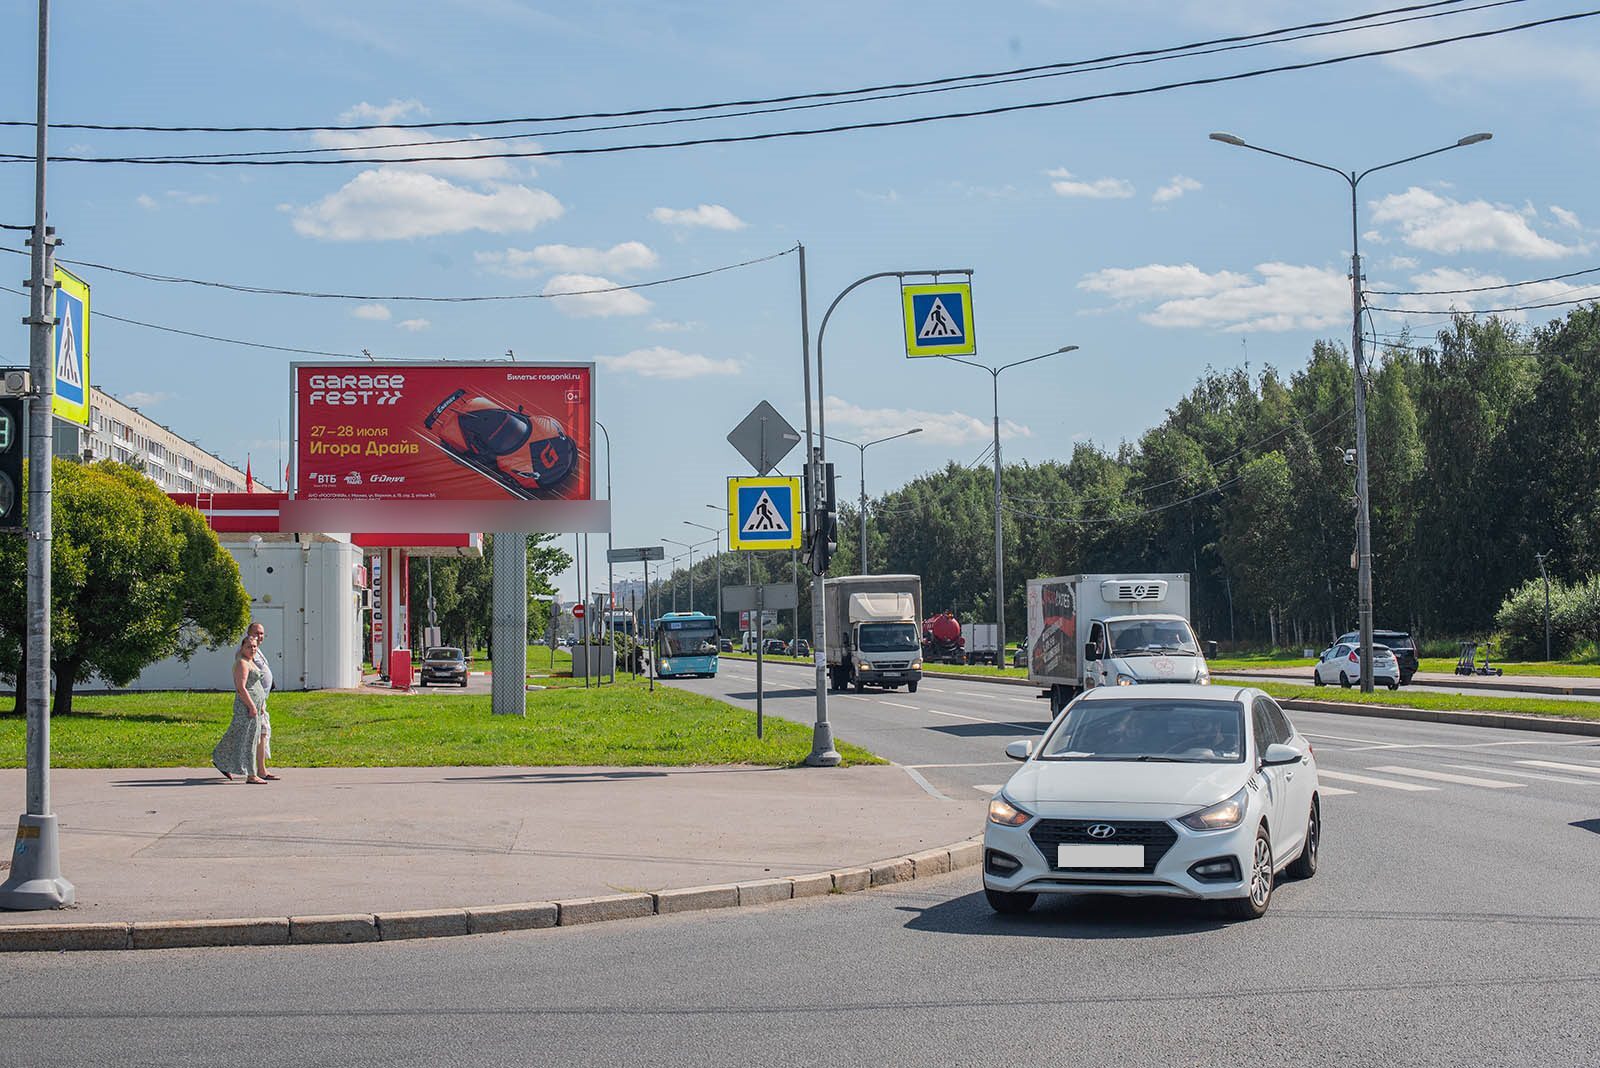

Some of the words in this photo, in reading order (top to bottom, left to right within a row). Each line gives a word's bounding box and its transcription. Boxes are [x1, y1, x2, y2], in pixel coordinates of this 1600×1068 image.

[309, 374, 405, 389] GARAGE
[538, 373, 581, 382] rosgonki.ru
[309, 391, 373, 405] FEST
[356, 428, 389, 437] июля
[309, 440, 361, 457] Игора
[365, 439, 419, 457] Драйв
[318, 474, 337, 484] ВТБ
